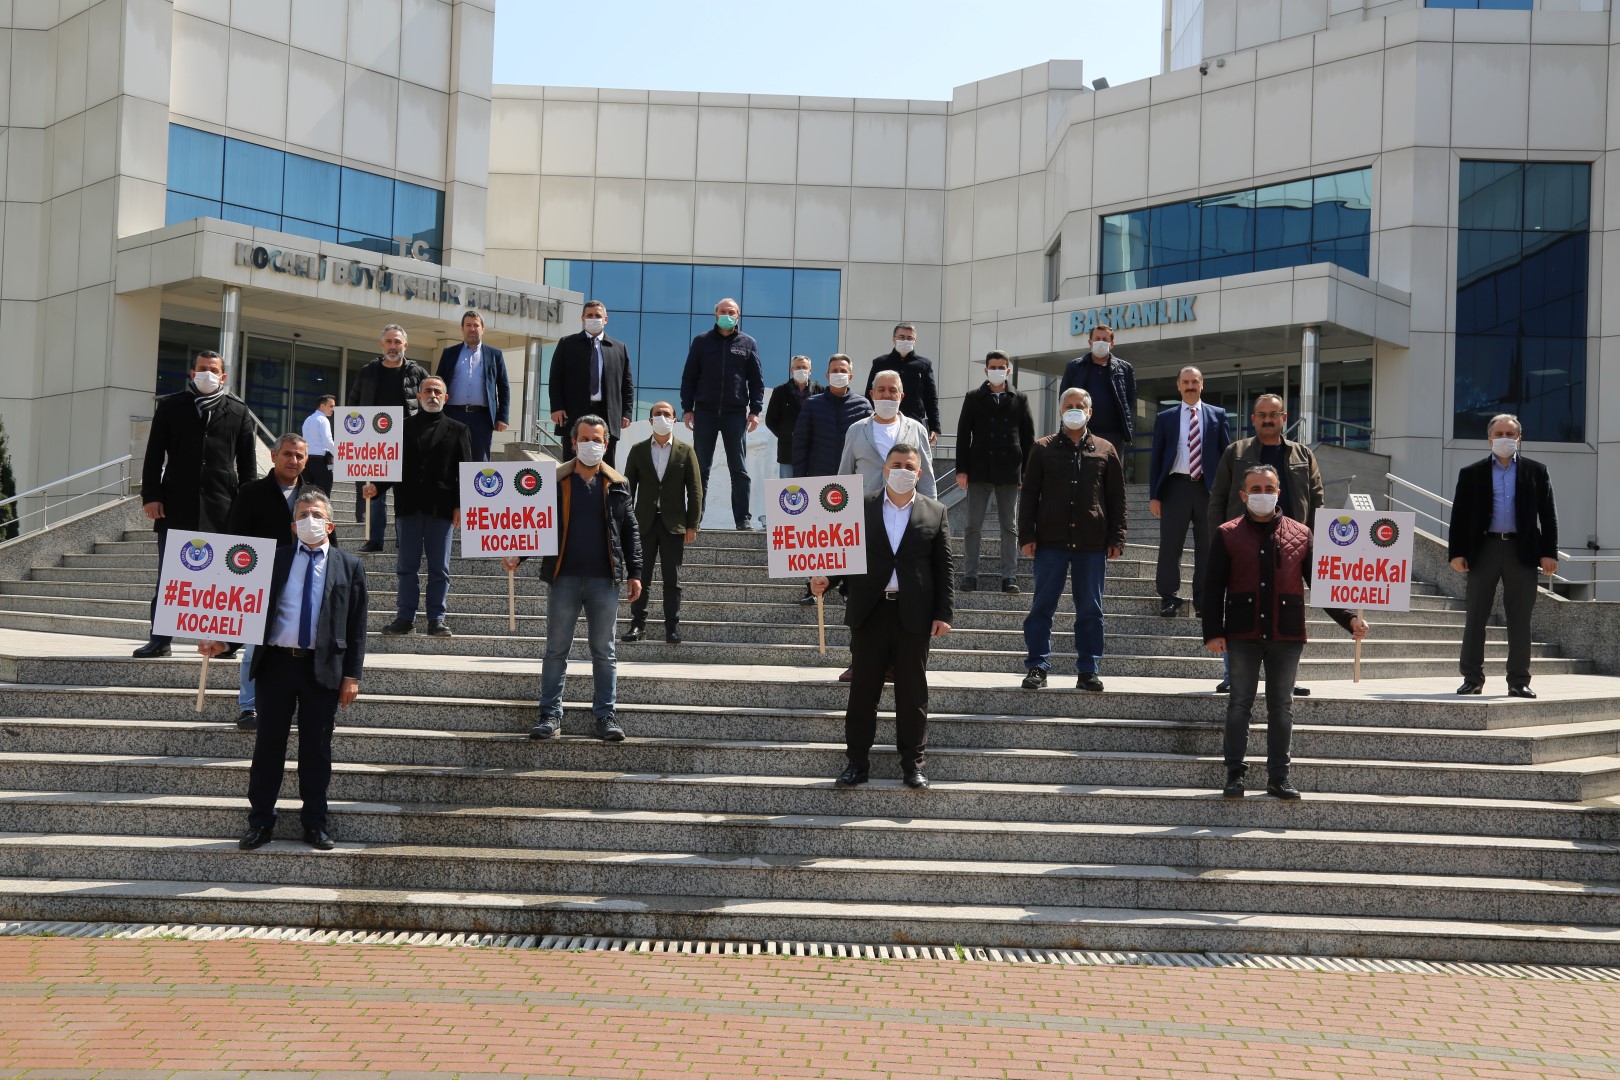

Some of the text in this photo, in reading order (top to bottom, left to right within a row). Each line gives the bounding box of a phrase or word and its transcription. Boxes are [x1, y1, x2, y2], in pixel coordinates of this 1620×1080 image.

[235, 242, 564, 324] KOCAELİ BÜYÜKŞEHİR BELEDİYESİ
[338, 442, 399, 460] #EvdeKal
[347, 461, 388, 477] KOCAELİ
[466, 505, 552, 531] #EvdeKal
[481, 530, 539, 551] KOCAELİ
[772, 521, 860, 550] #EvdeKal
[788, 548, 847, 571] KOCAELİ
[1317, 555, 1407, 583] #EvdeKal
[164, 580, 264, 614] #EvdeKal
[1330, 584, 1390, 605] KOCAELİ
[176, 613, 244, 636] KOCAELİ
